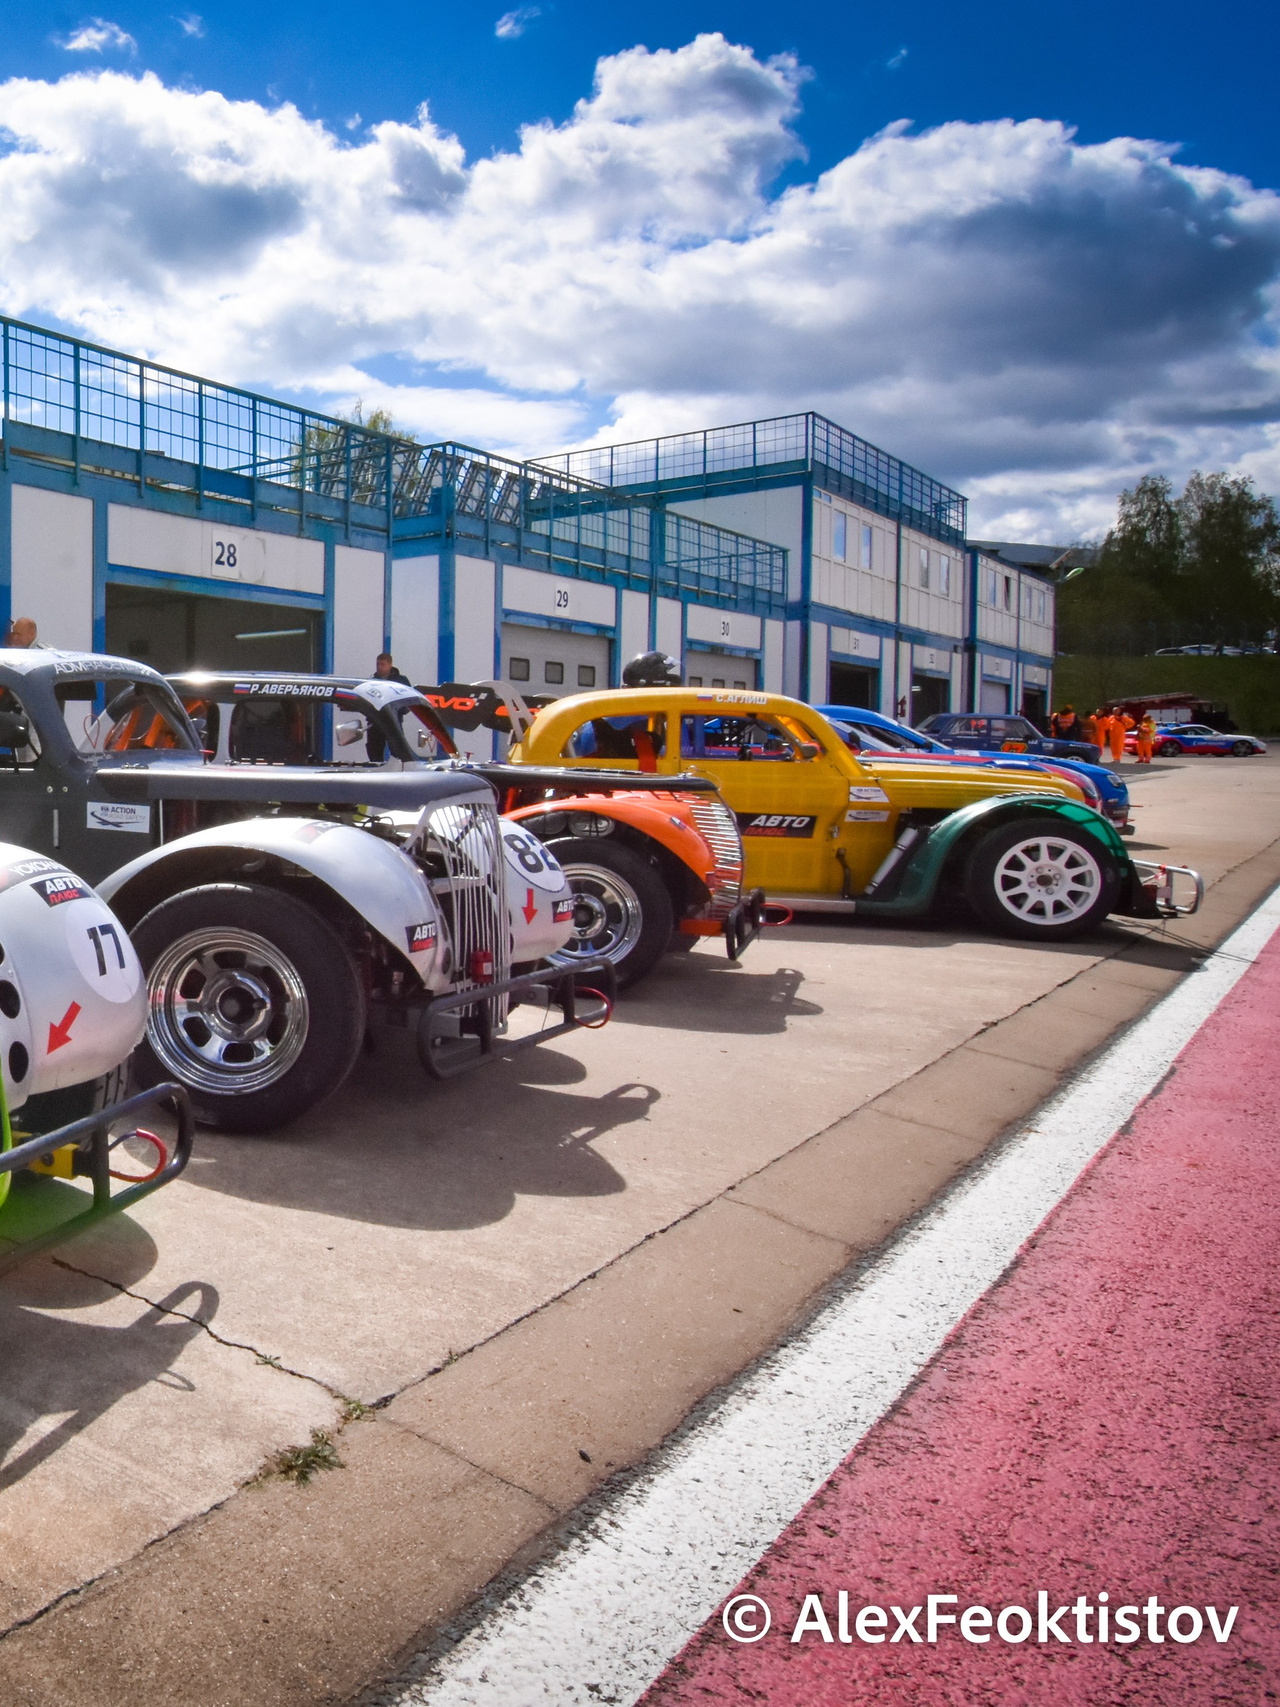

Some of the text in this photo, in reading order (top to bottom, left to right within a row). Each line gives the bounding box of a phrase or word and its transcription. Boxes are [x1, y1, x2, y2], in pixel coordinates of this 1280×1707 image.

[215, 541, 237, 567] 28
[557, 590, 568, 608] 29
[721, 621, 729, 636] 30
[250, 683, 334, 697] Р.АВЕРЬЯНОВ
[111, 806, 136, 815] ACTION
[751, 815, 811, 828] АВТО
[503, 833, 562, 873] 82
[45, 876, 83, 895] АВТО
[49, 889, 79, 904] ПЛЮС
[86, 923, 126, 977] 17
